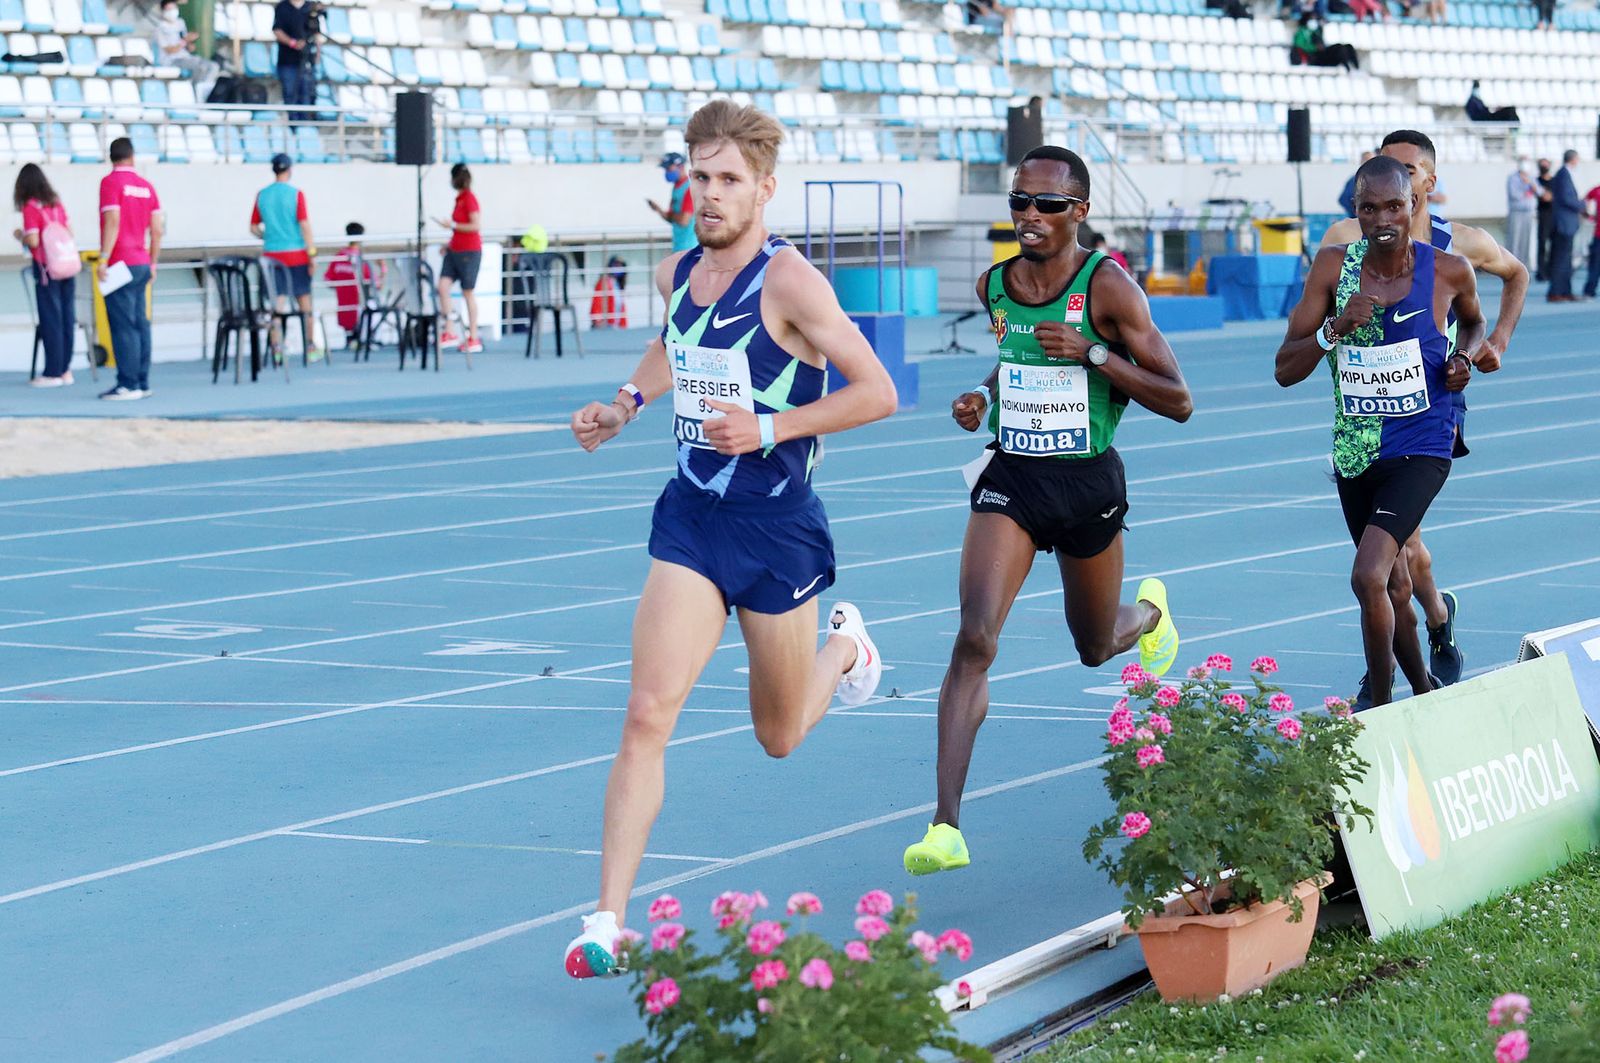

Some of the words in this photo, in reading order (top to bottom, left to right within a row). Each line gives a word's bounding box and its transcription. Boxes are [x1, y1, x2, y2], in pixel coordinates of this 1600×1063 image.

[1377, 352, 1409, 362] HUELVA
[701, 361, 729, 370] HUELVA
[1341, 365, 1421, 384] KIPLANGAT
[677, 377, 741, 397] GRESSIER
[1036, 379, 1072, 387] HUELVA
[1376, 387, 1389, 396] 48
[1001, 399, 1085, 414] NDIKUMWENAYO
[1031, 418, 1043, 430] 52
[1432, 738, 1580, 841] IBERDROLA
